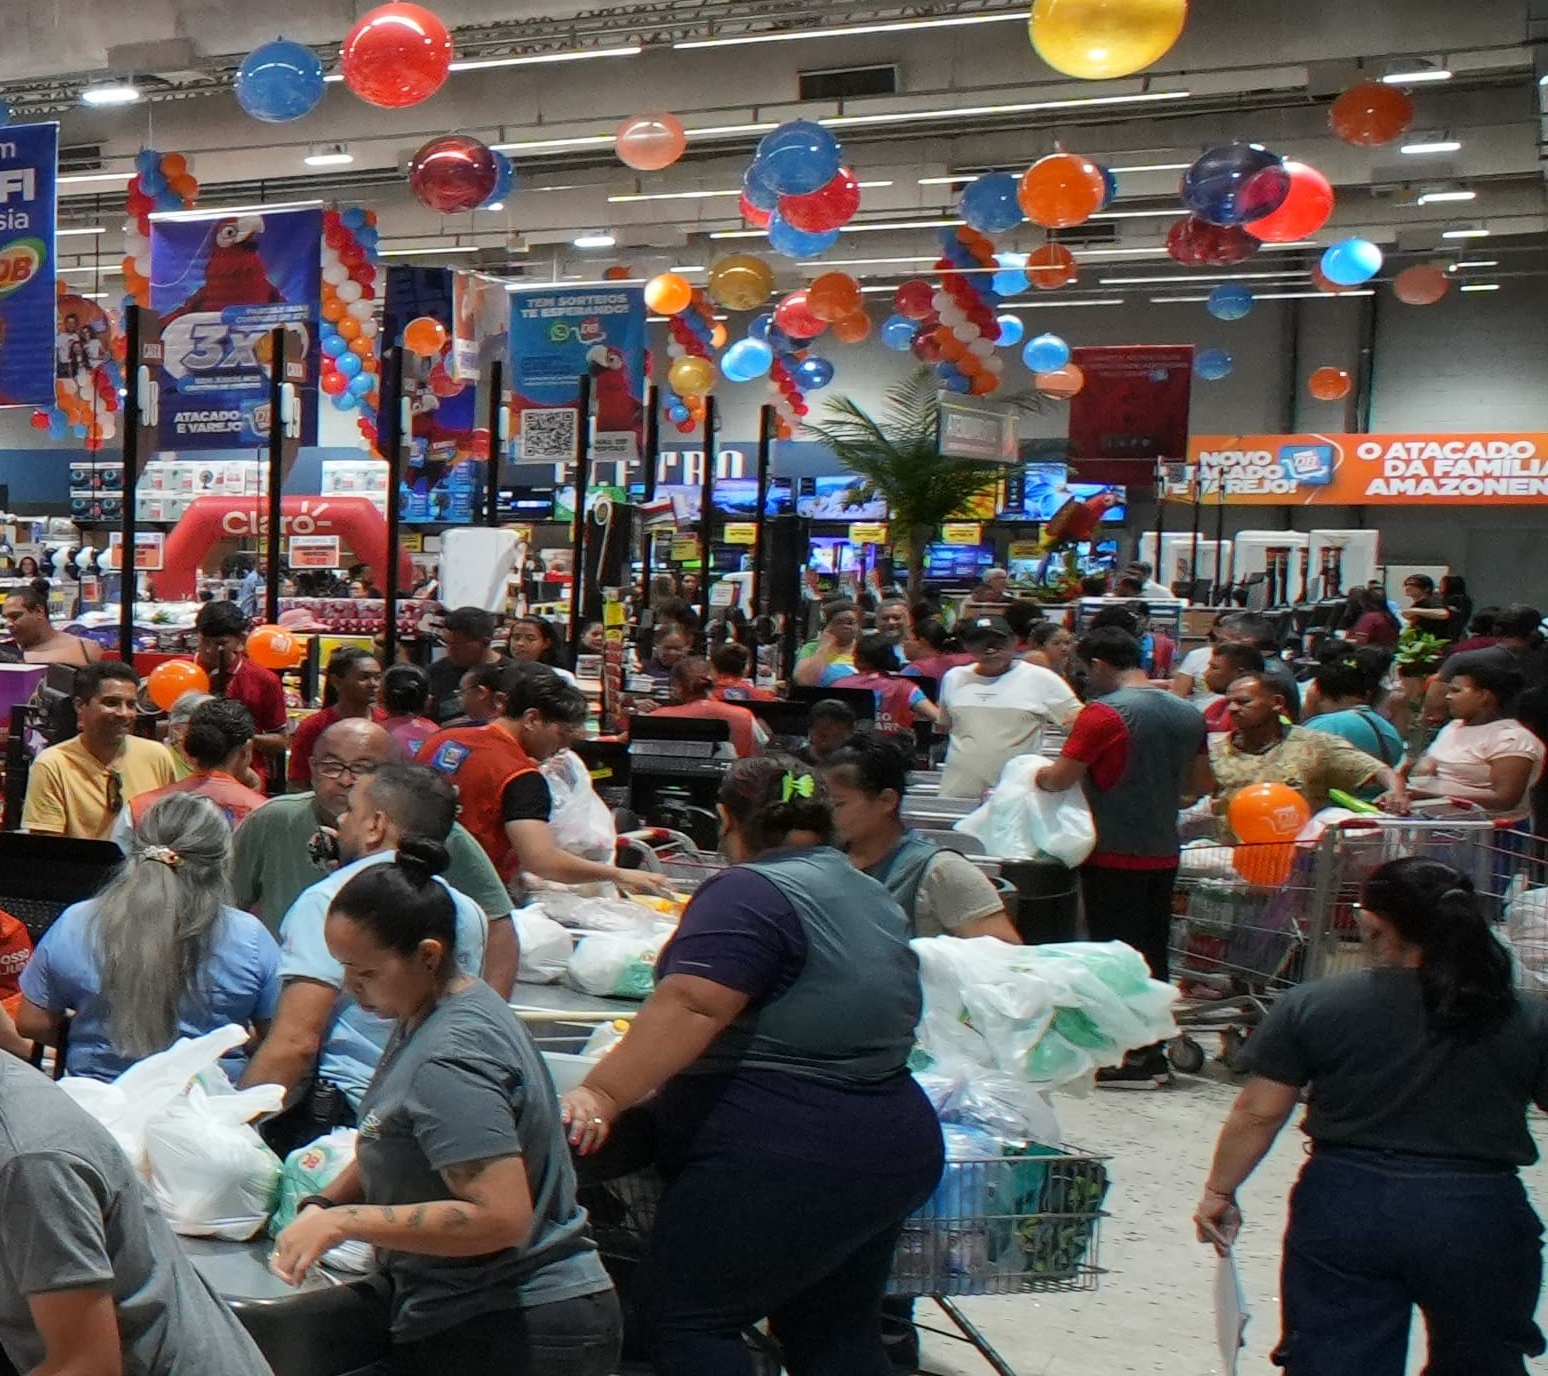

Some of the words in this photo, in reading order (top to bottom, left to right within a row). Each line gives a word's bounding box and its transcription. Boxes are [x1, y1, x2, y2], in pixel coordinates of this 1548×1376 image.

[174, 410, 241, 423] ATACADO
[177, 423, 187, 434] E
[1199, 450, 1273, 466] NOVO
[1357, 442, 1382, 461] O
[1384, 440, 1537, 461] ATACADO
[1384, 459, 1431, 478] DA
